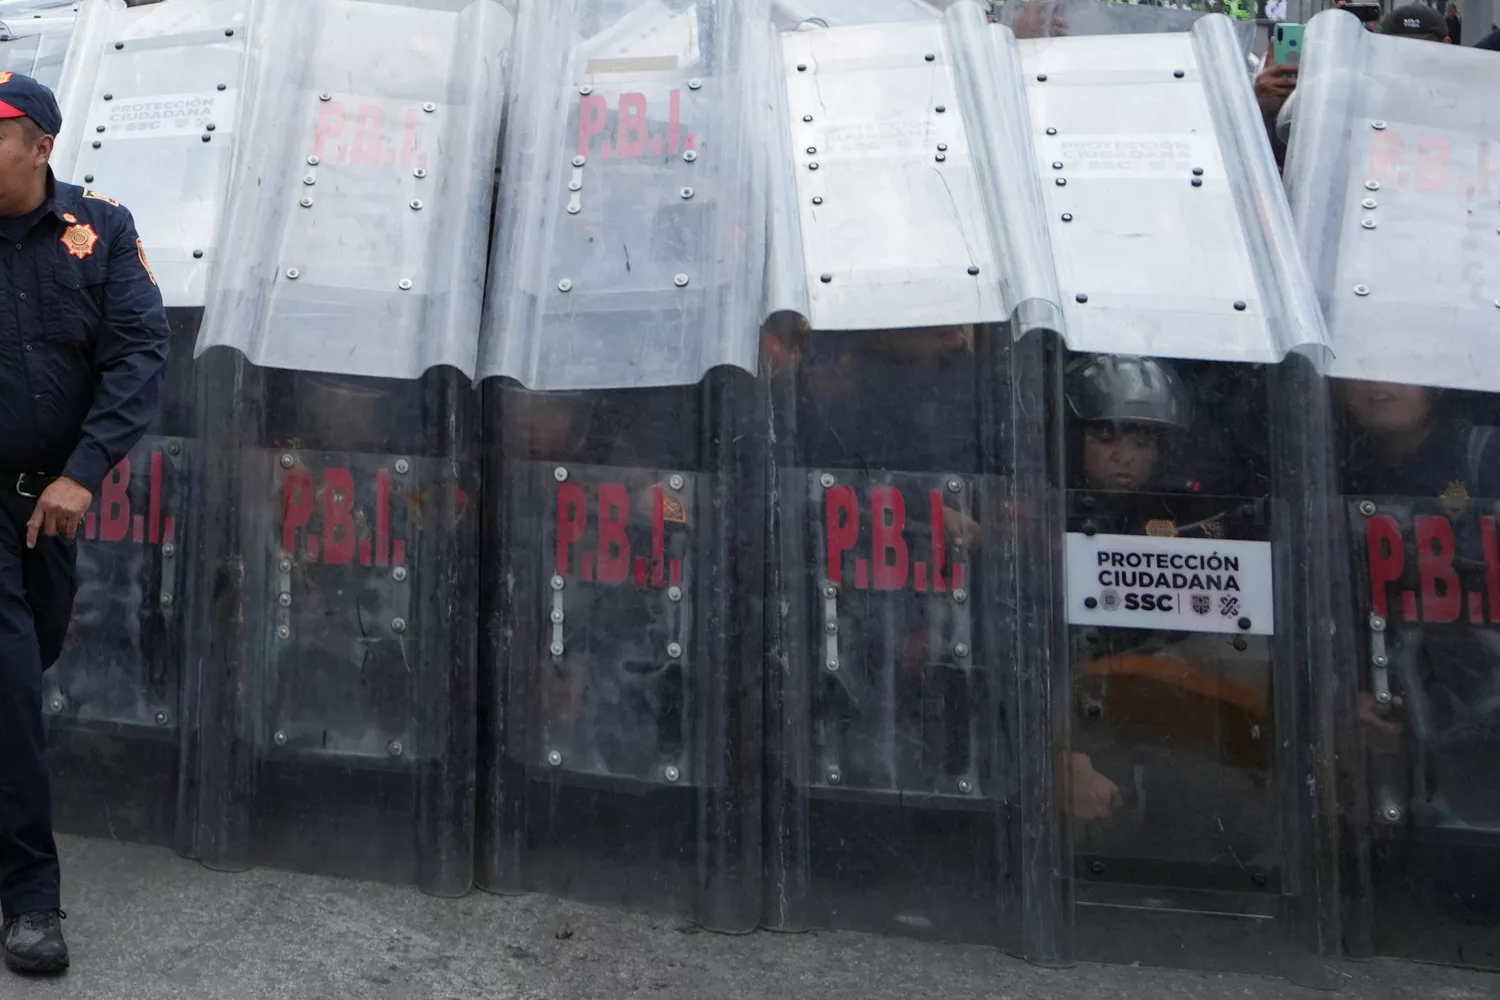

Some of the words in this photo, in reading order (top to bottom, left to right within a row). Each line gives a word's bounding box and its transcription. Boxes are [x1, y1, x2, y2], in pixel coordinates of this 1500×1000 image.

[109, 108, 213, 121] CIUDADANA
[111, 97, 215, 113] PROTECCIÓN
[125, 121, 162, 132] SSC
[578, 88, 697, 161] P.B.I.
[1062, 150, 1191, 160] CIUDADANA
[85, 450, 176, 544] .B.I.
[283, 467, 406, 568] P.B.I.
[556, 482, 683, 589] P.B.I.
[826, 485, 966, 593] P.B.I.
[1097, 551, 1240, 572] PROTECCIÓN
[1098, 570, 1241, 592] CIUDADANA
[1124, 592, 1173, 612] SSC
